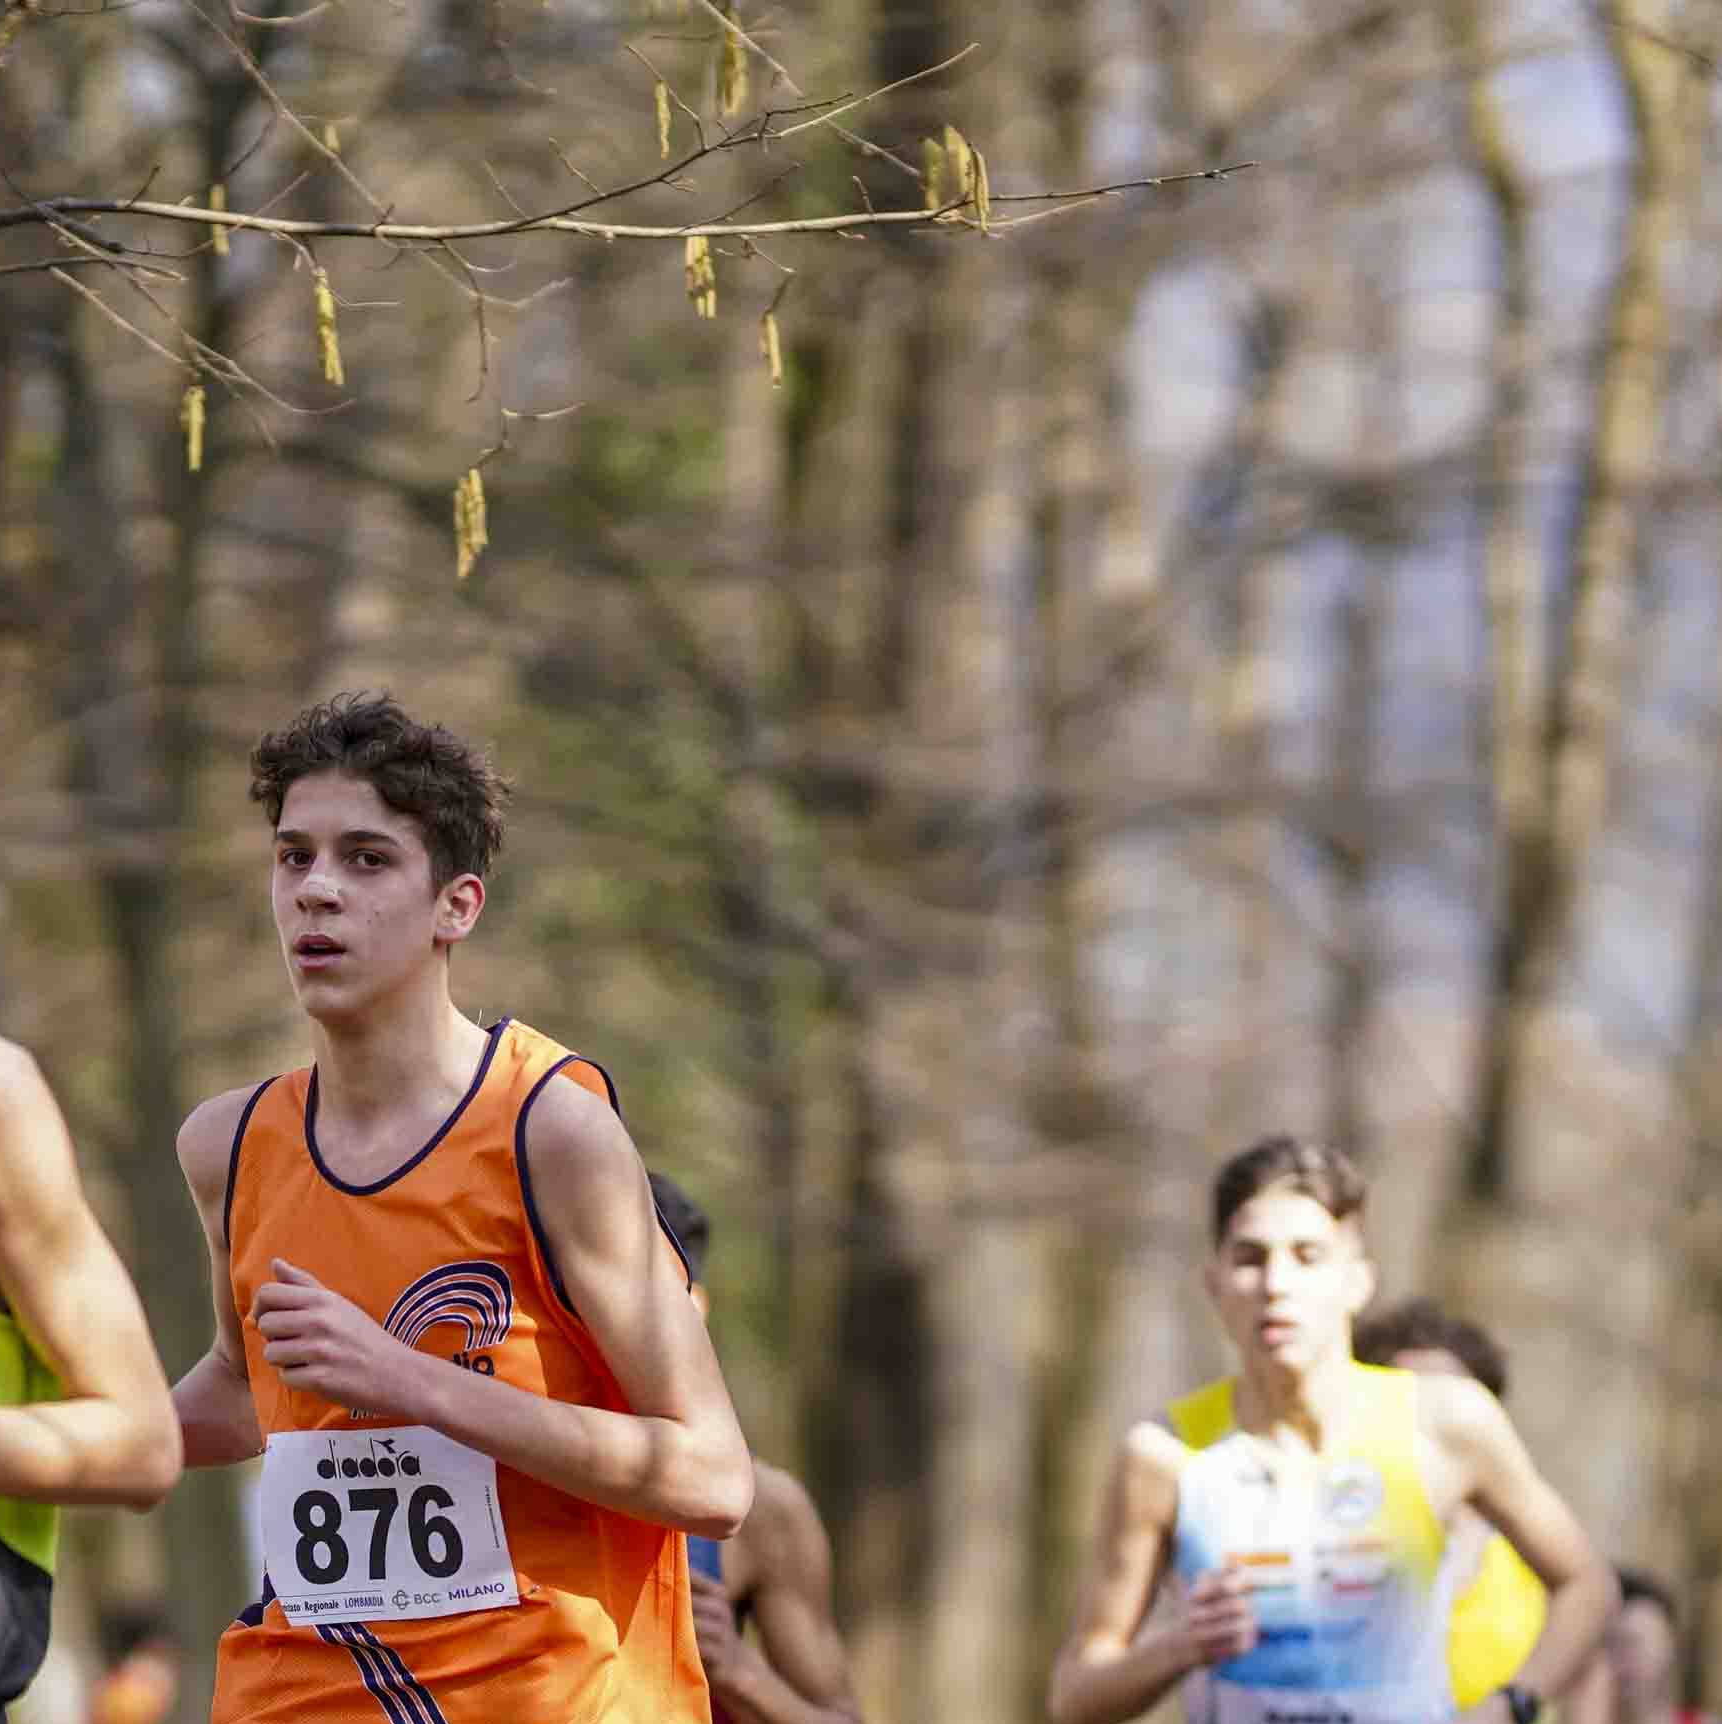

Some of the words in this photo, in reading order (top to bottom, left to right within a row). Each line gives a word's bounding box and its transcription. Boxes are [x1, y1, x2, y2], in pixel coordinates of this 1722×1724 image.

[317, 1437, 422, 1479] diadora
[293, 1484, 464, 1585] 876
[413, 1592, 440, 1605] BCC
[448, 1582, 505, 1601] MILANO
